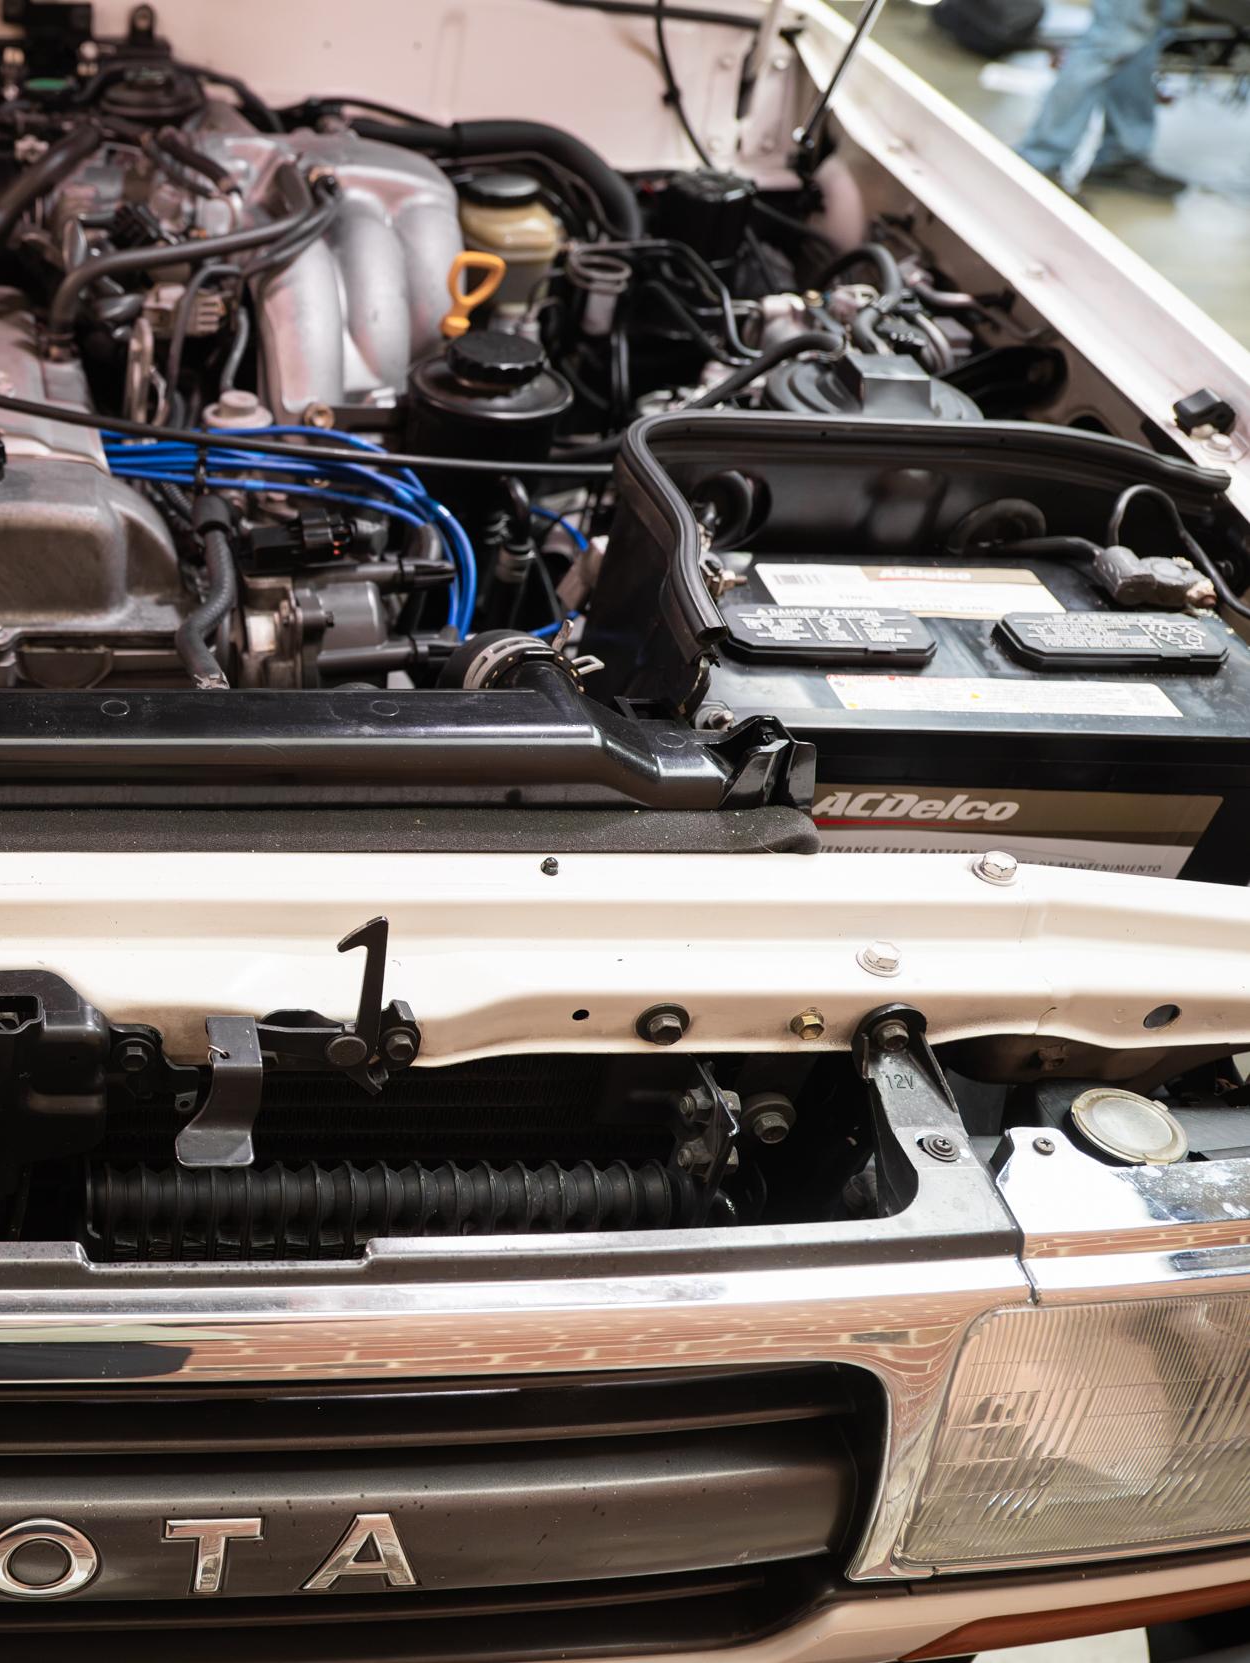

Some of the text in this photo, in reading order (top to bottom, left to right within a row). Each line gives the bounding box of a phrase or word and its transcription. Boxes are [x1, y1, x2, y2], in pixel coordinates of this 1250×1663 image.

[767, 608, 822, 618] DANGER
[831, 609, 880, 619] POISON
[812, 791, 1020, 821] ACDelco
[885, 1074, 914, 1090] 12V
